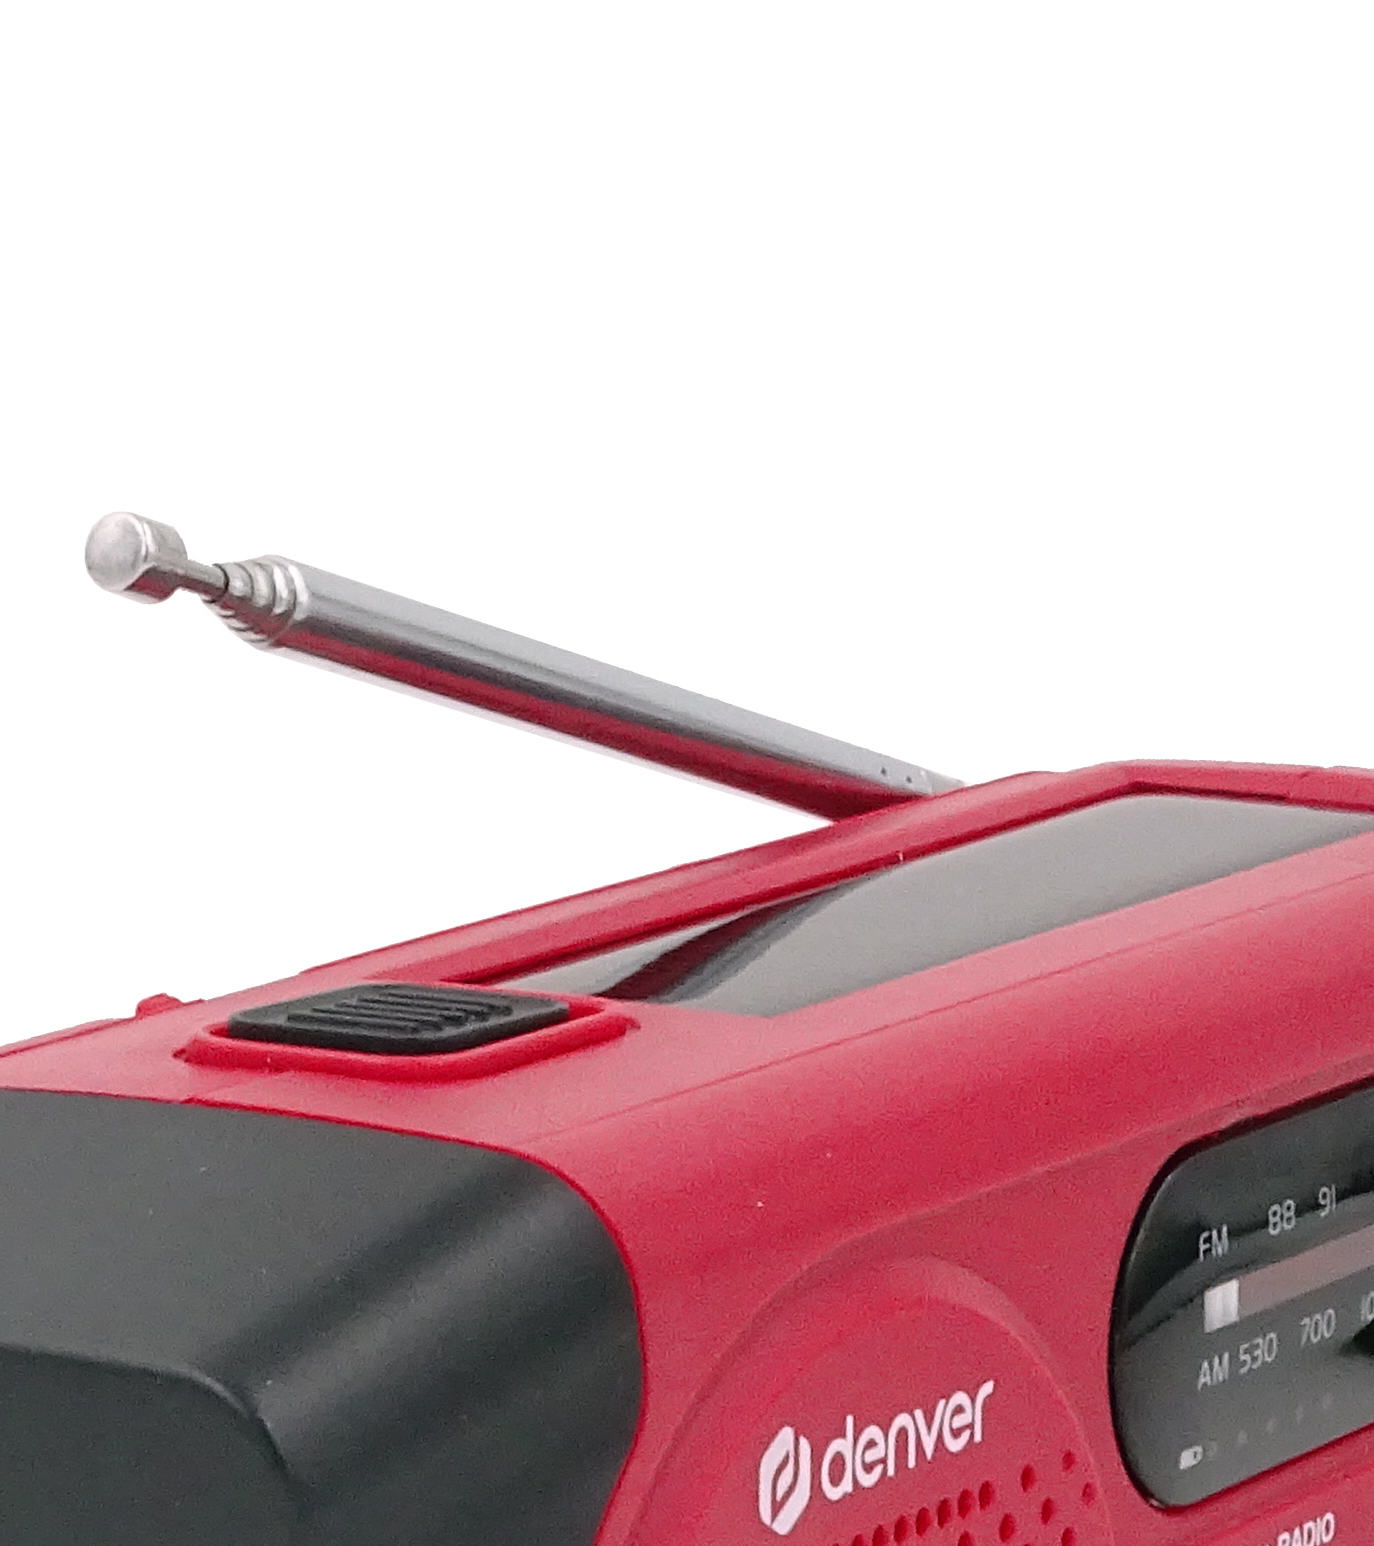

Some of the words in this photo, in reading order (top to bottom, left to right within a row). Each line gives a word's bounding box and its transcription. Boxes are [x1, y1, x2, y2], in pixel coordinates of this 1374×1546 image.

[1199, 1224, 1229, 1262] FM
[1268, 1199, 1296, 1236] 88
[1318, 1184, 1337, 1217] 91
[1197, 1352, 1230, 1391] AM
[1239, 1333, 1278, 1374] 530
[1300, 1308, 1337, 1346] 700
[820, 1379, 995, 1501] denver
